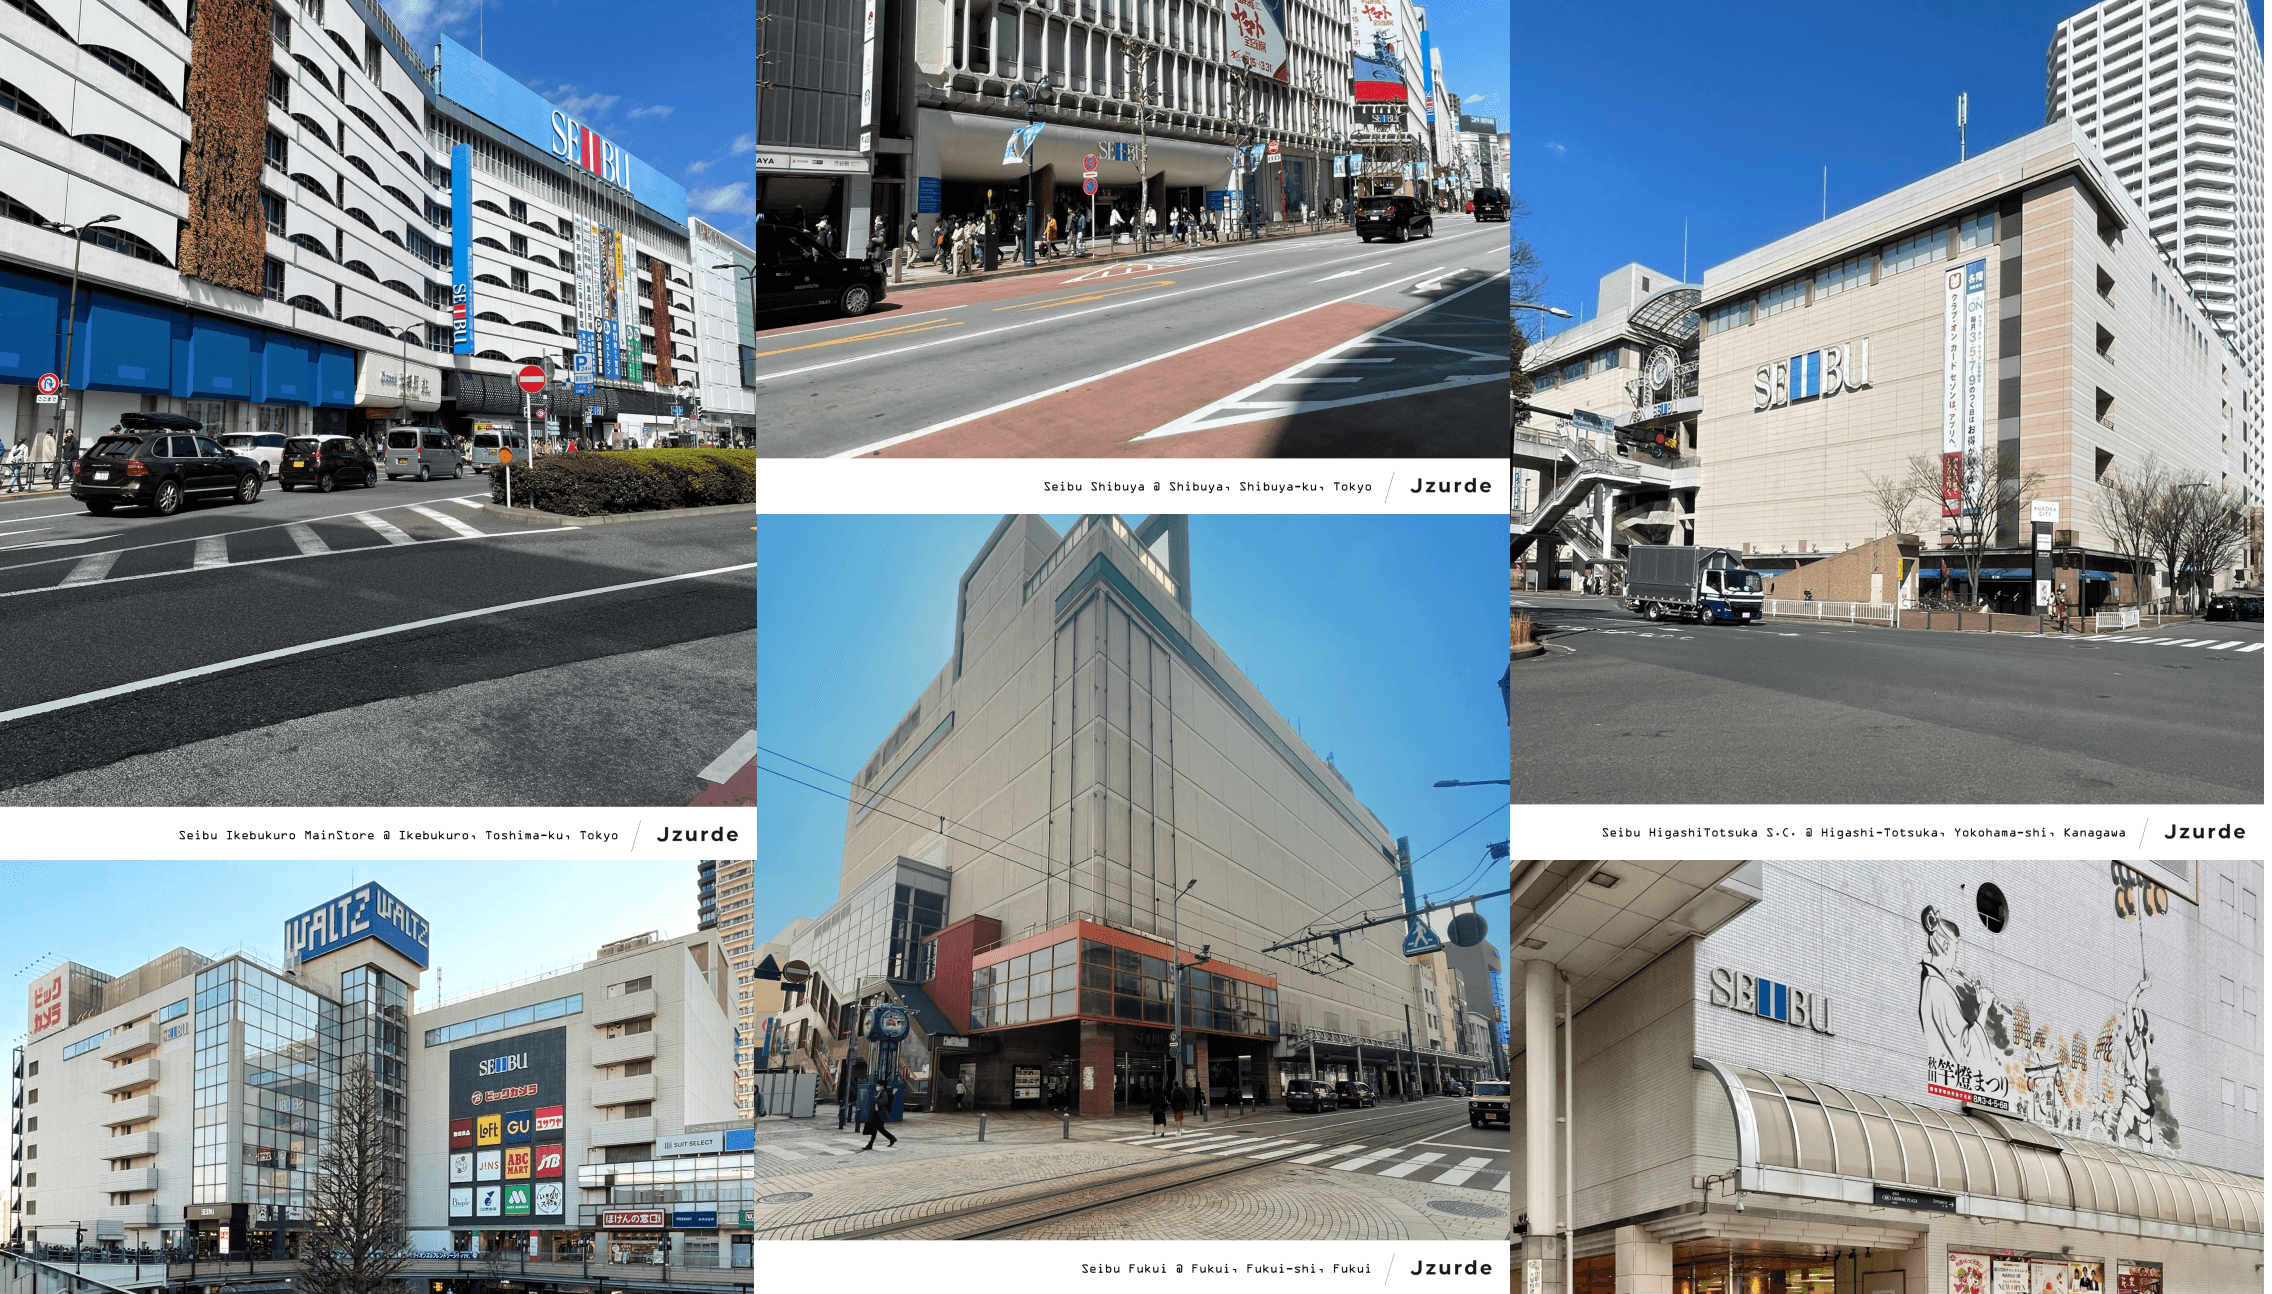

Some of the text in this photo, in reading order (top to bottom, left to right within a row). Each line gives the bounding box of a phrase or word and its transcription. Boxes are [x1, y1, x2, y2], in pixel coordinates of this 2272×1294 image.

[1231, 2, 1265, 39] ヤマト
[1362, 5, 1392, 21] ヤマト
[552, 110, 631, 192] SEIBU
[453, 284, 466, 344] SEIBU
[576, 356, 587, 371] P
[1754, 337, 1872, 411] SEIBU
[1653, 401, 1678, 418] SEIBU
[286, 888, 370, 960] WALTZ
[377, 889, 429, 948] WALTZ
[34, 976, 61, 1009] ビック
[1711, 966, 1836, 1036] SEIBU
[34, 1002, 61, 1034] カメラ
[163, 1022, 188, 1042] SEIBU
[480, 1052, 528, 1076] SEIBU
[1928, 1056, 1937, 1083] 秋田
[1938, 1058, 2009, 1099] 竿燈まつり
[485, 1084, 538, 1103] ビックカメラ
[507, 1119, 530, 1134] GU
[689, 1139, 714, 1147] SELECT
[507, 1165, 528, 1174] MART
[508, 1152, 528, 1166] ABC
[537, 1153, 561, 1171] JTB
[605, 1213, 658, 1224] ほけんの窓口
